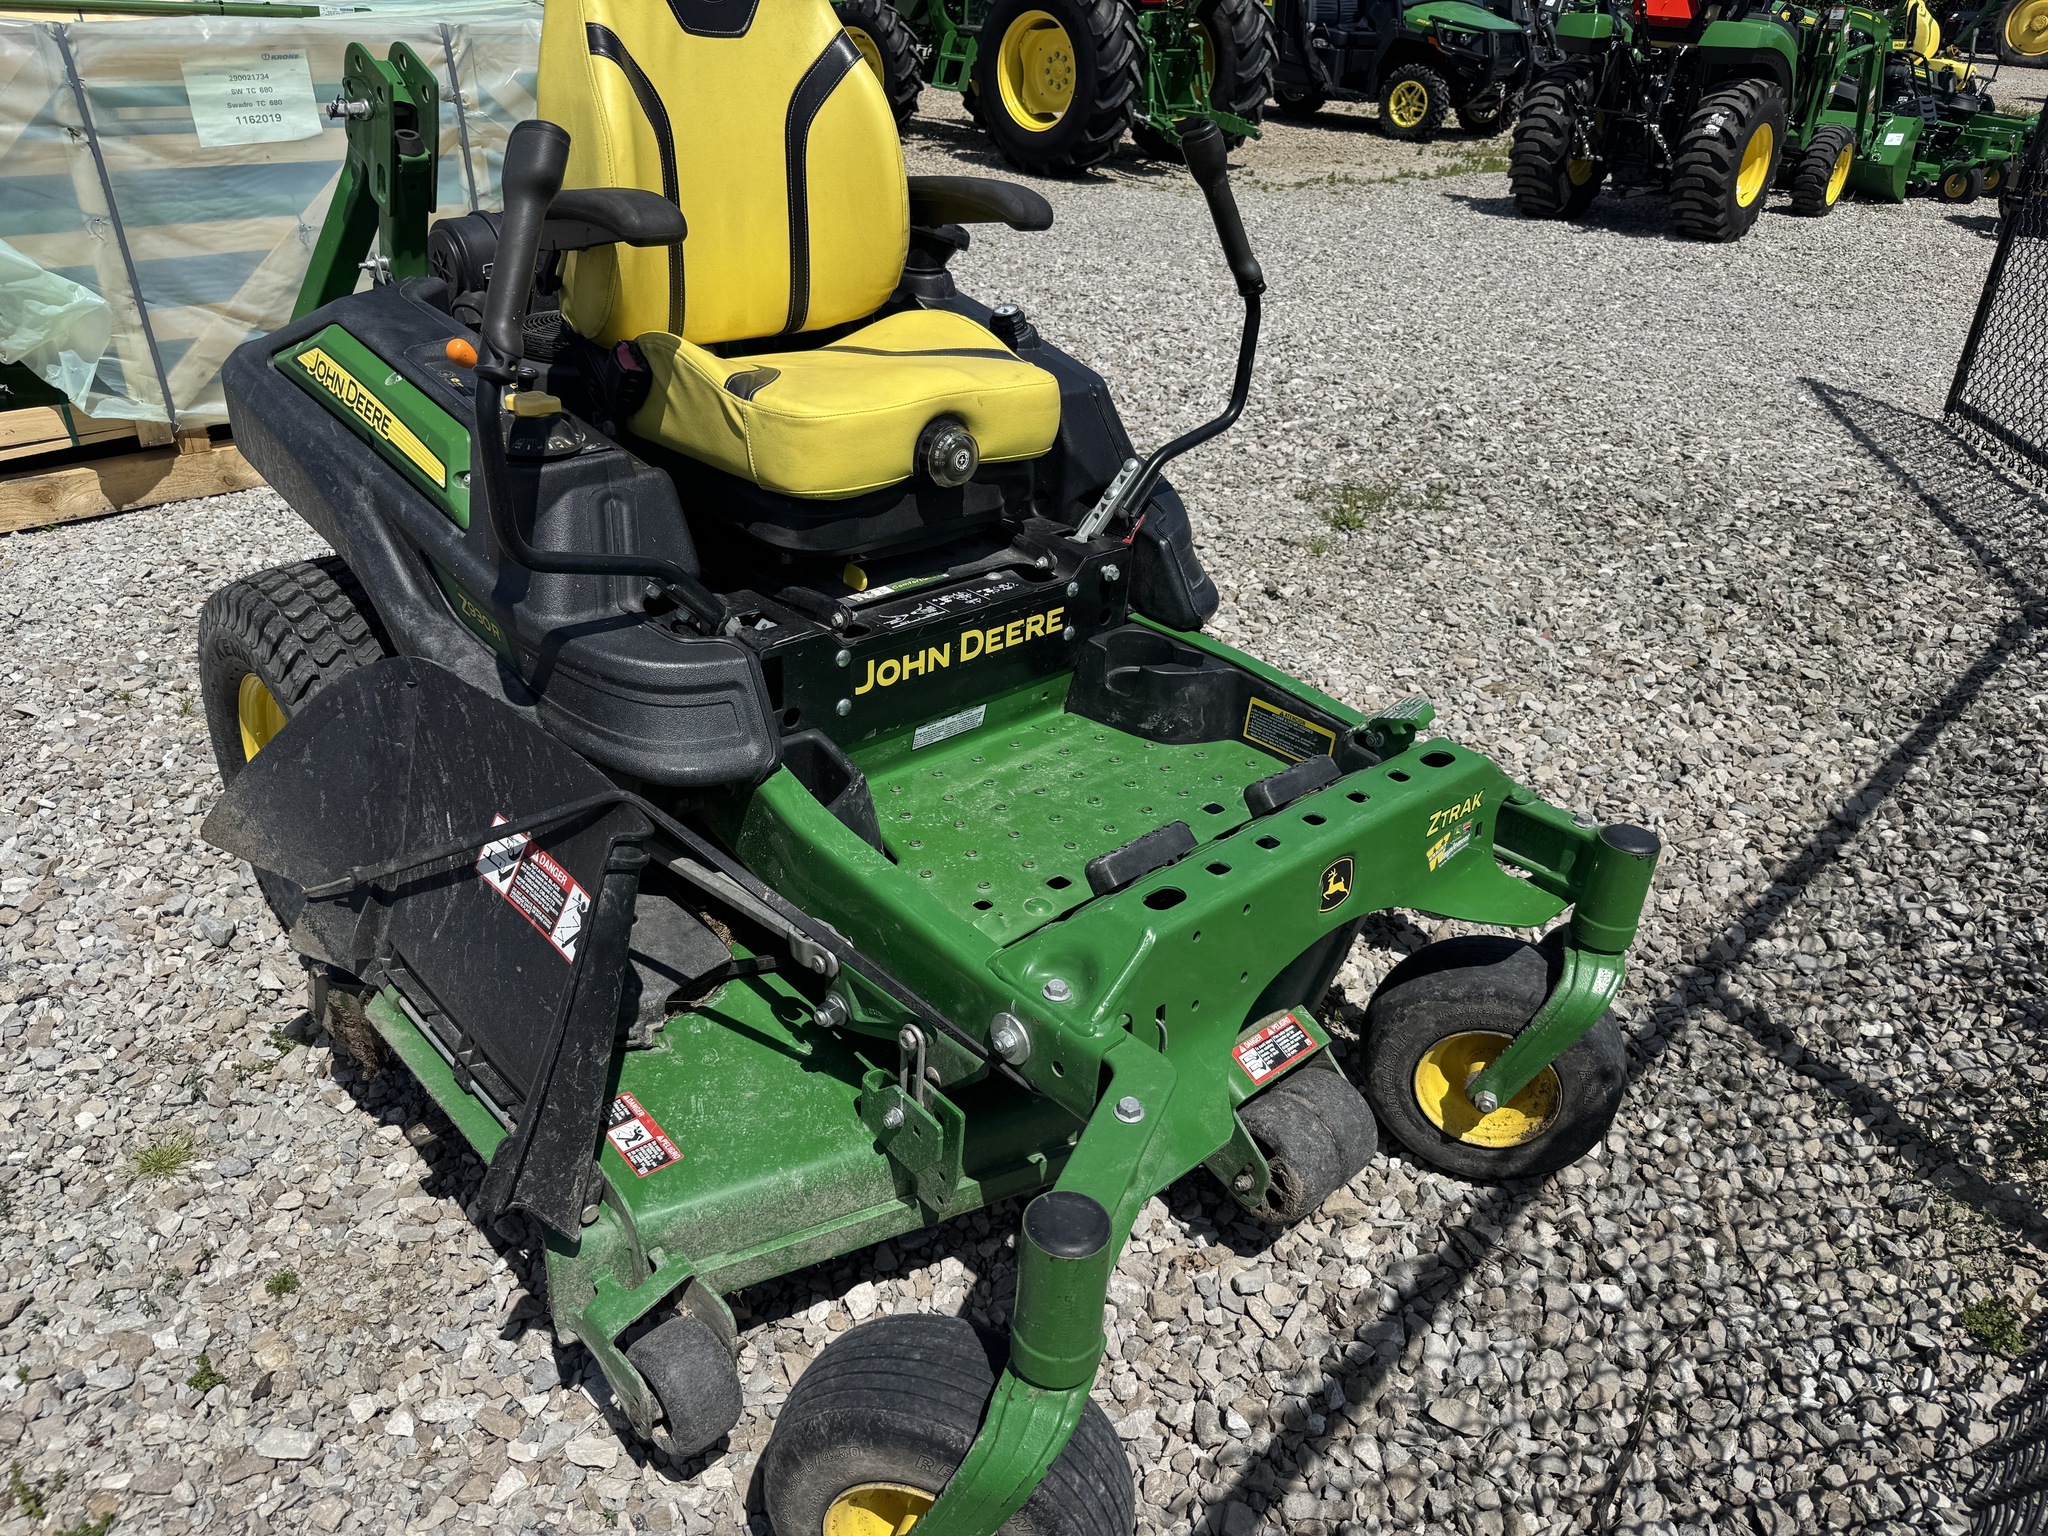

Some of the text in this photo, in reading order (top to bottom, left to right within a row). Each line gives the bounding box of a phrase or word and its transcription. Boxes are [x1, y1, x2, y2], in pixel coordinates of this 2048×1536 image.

[229, 73, 270, 82] 290021734
[231, 88, 243, 96] SW
[259, 86, 273, 94] 680
[227, 101, 254, 109] Swadro
[269, 99, 283, 107] 680
[235, 113, 282, 125] 1162019
[309, 353, 393, 438] JOHN DEERE
[458, 592, 501, 642] Z930R
[855, 642, 950, 695] JOHN
[960, 606, 1065, 663] DEERE
[1426, 790, 1484, 838] ZTRAK
[538, 853, 568, 887] DANGER
[1382, 1029, 1412, 1121] CARLISLE
